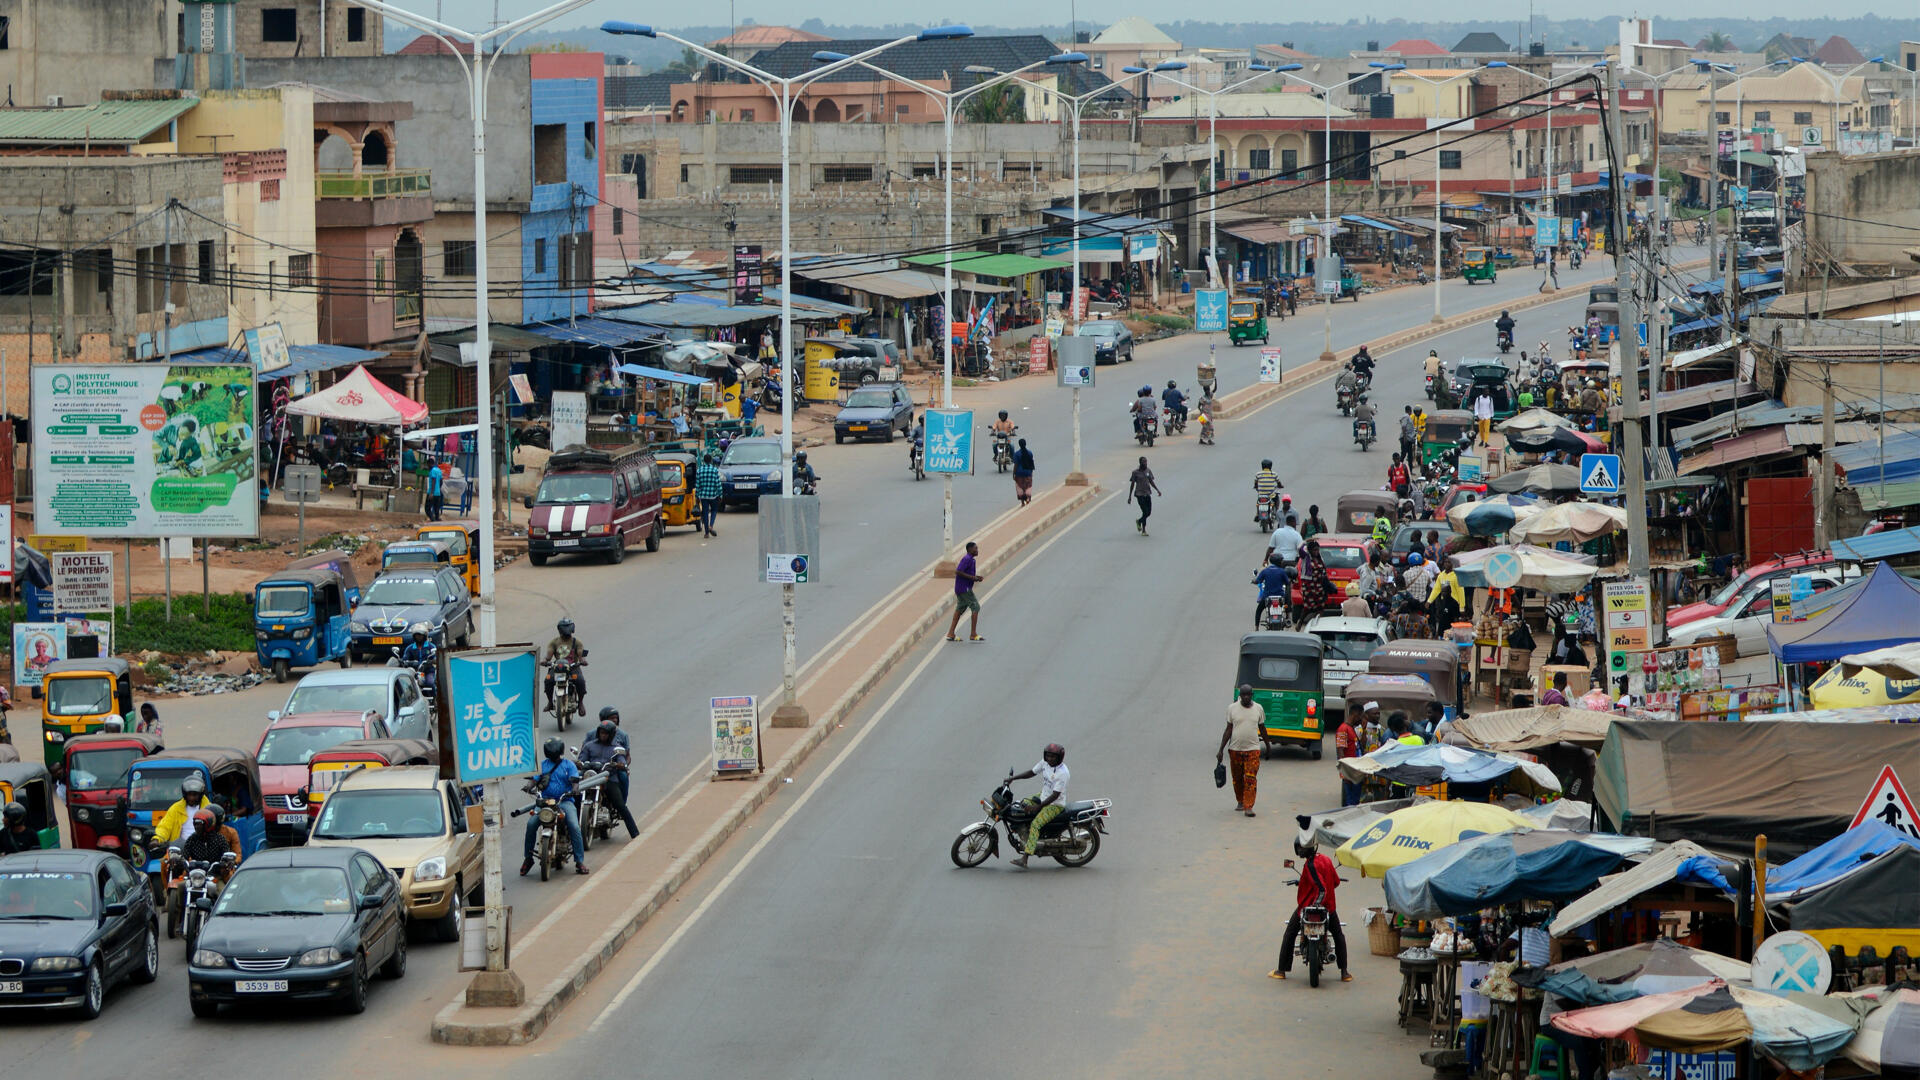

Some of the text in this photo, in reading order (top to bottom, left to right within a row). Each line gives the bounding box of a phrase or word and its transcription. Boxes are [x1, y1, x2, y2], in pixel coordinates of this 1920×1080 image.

[931, 434, 944, 442] JE
[931, 443, 959, 454] VOTE
[930, 456, 964, 468] UNIR
[62, 557, 104, 566] MOTEL
[68, 566, 109, 575] PRINTEMPS
[1615, 634, 1630, 645] Ria
[464, 703, 484, 720] JE
[466, 720, 512, 744] VOTE
[274, 982, 286, 990] BG
